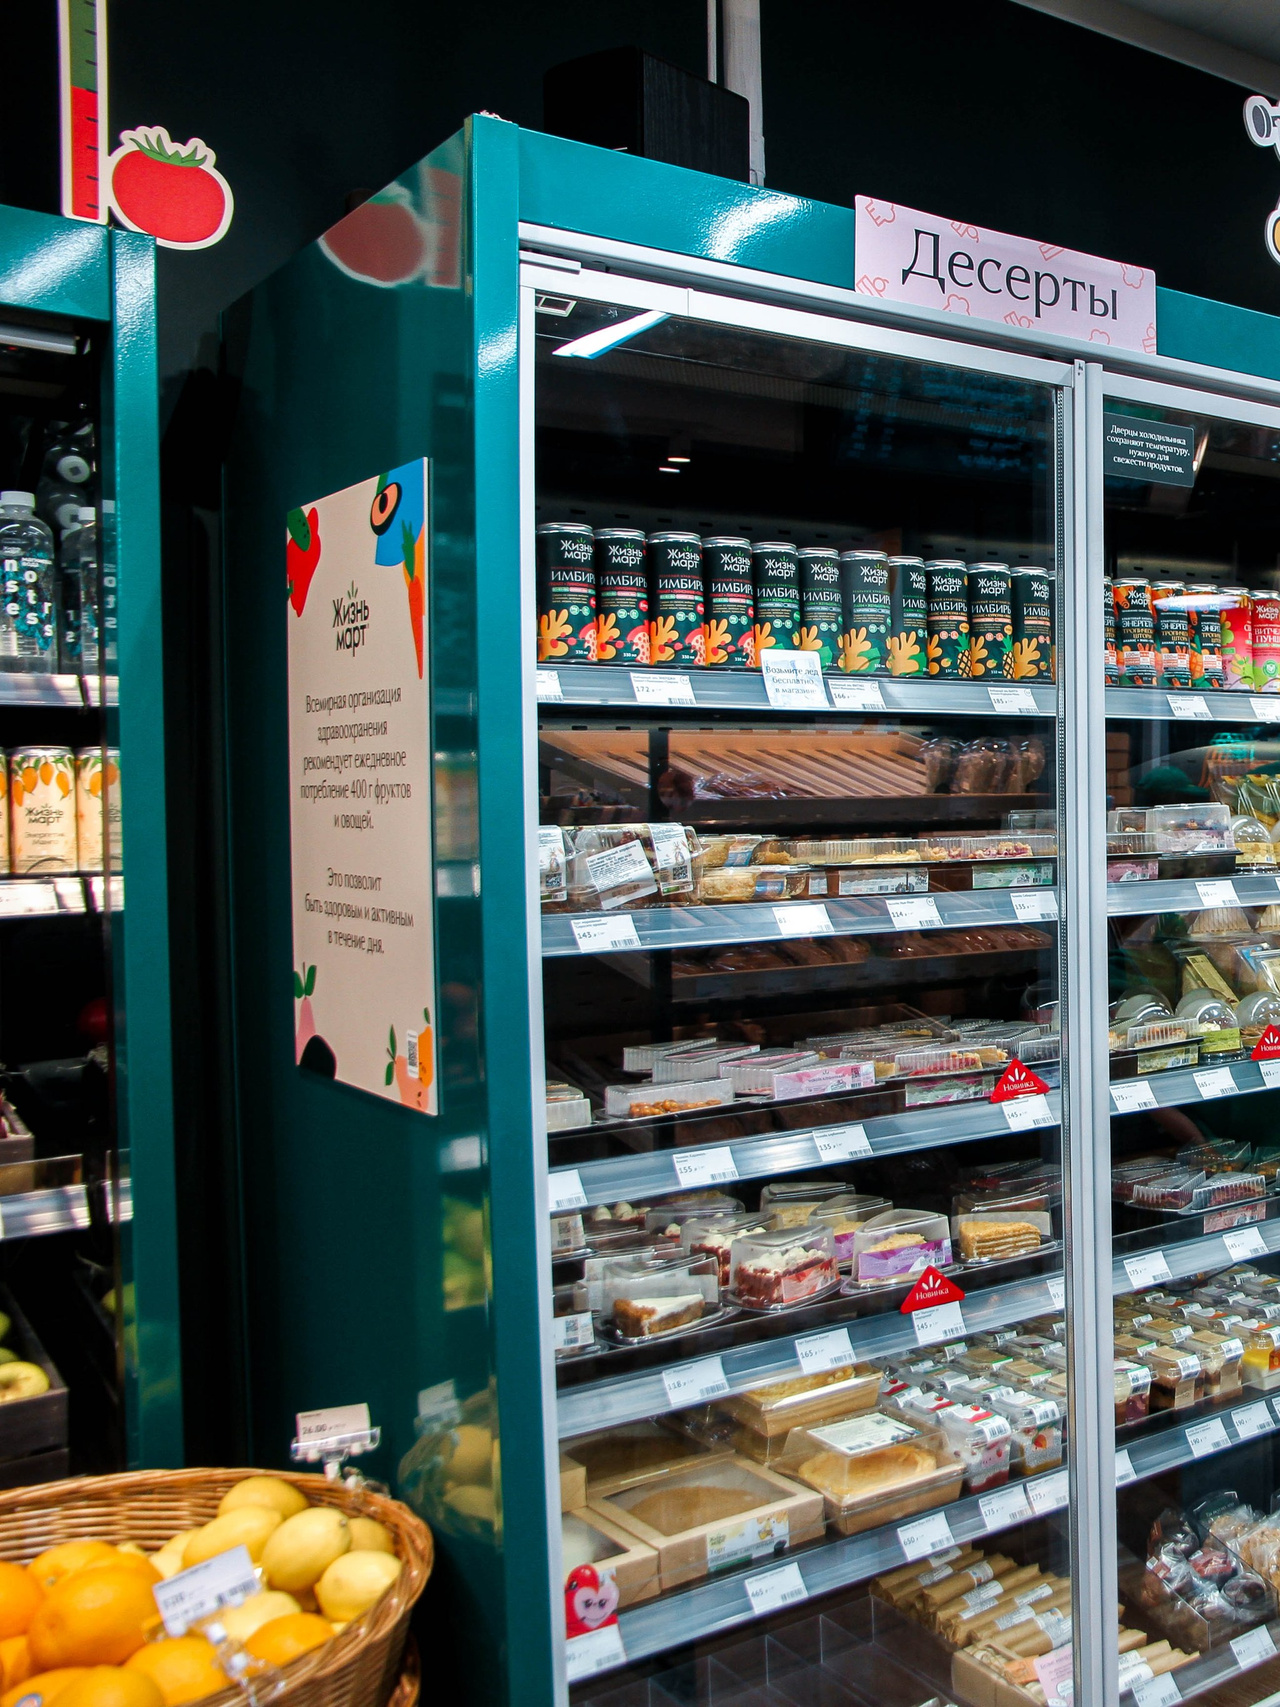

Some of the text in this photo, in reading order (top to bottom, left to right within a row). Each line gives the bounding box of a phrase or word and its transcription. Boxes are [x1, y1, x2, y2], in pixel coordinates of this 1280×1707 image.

[901, 228, 1118, 321] Десерты
[1110, 425, 1187, 446] Дверцы холодильника
[1129, 449, 1156, 460] нужную
[1113, 456, 1147, 467] свежести
[561, 540, 593, 553] Жизнь
[608, 545, 642, 557] Жизнь
[564, 551, 592, 562] март
[667, 549, 699, 561] Жизнь
[720, 554, 750, 565] Жизнь
[612, 556, 641, 567] март
[671, 559, 699, 570] март
[765, 559, 796, 570] Жизнь
[724, 563, 750, 574] март
[768, 569, 795, 579] март
[811, 564, 839, 575] Жизнь
[861, 566, 888, 577] Жизнь
[601, 576, 647, 588] ИМБИРЬ
[814, 573, 838, 583] март
[864, 575, 887, 586] март
[910, 572, 926, 581] Жиз
[932, 576, 962, 585] Жизнь
[913, 582, 926, 592] мар
[935, 584, 960, 594] март
[978, 579, 1006, 588] Жизнь
[1031, 582, 1049, 591] Жизн
[981, 587, 1005, 597] март
[1034, 591, 1049, 600] мар
[803, 592, 842, 604] ИМБИР
[853, 594, 891, 605] ИМБИР
[1131, 599, 1149, 607] мар
[332, 599, 370, 628] Жизнь
[972, 604, 1011, 614] ИМБИРЬ
[1024, 607, 1050, 616] ИМБИ
[1256, 605, 1279, 613] Жизнь
[1259, 613, 1278, 621] март
[336, 626, 367, 657] март
[306, 686, 402, 716] Всемирная организация
[317, 719, 388, 744] здравоохранения
[303, 750, 407, 774] рекомендует ежедневное
[300, 777, 412, 805] потребление 400 г фруктов
[25, 807, 64, 817] Жизнь
[28, 815, 62, 826] март
[334, 809, 374, 831] и овощей.
[327, 867, 382, 892] Это позволит
[304, 893, 415, 928] быть здоровым и активным
[328, 929, 384, 954] в течение дня.
[1003, 1080, 1035, 1092] Новинка
[819, 1143, 832, 1151] 135
[678, 1166, 693, 1174] 155
[916, 1287, 950, 1300] Новинка
[916, 1322, 929, 1331] 145
[800, 1350, 814, 1359] 165
[903, 1535, 915, 1545] 650
